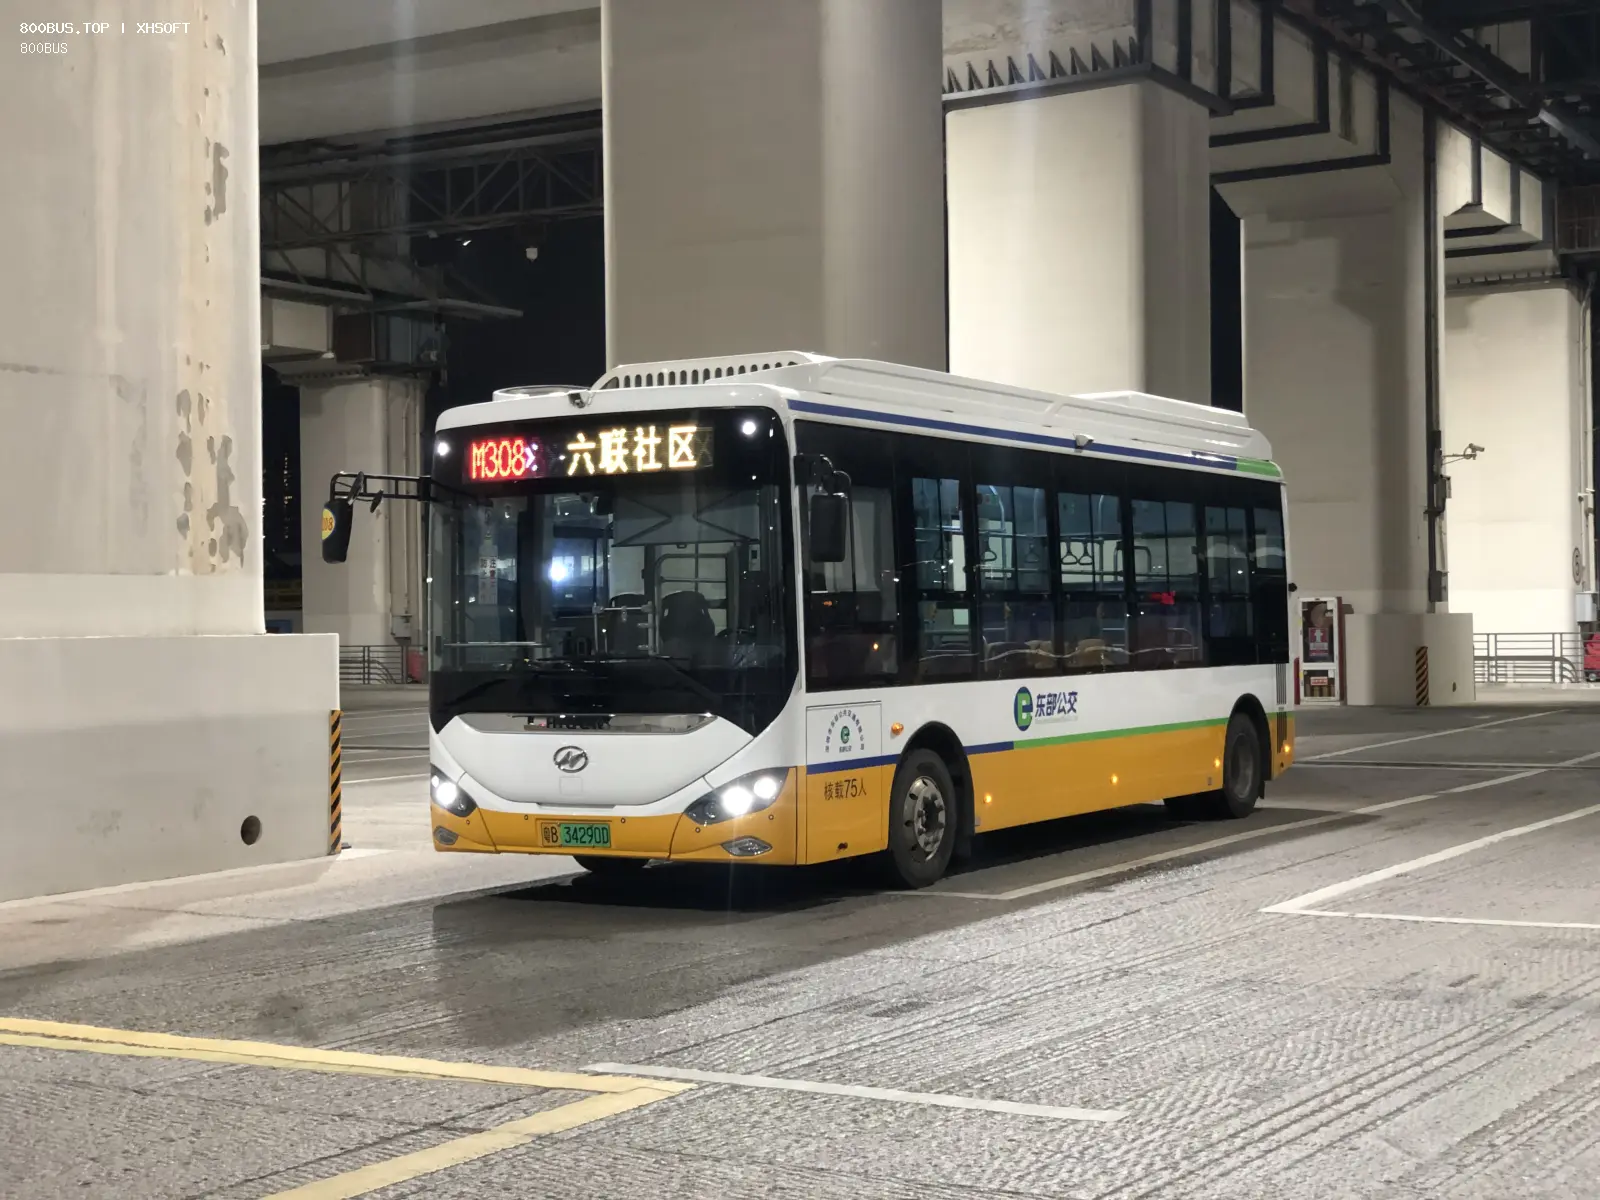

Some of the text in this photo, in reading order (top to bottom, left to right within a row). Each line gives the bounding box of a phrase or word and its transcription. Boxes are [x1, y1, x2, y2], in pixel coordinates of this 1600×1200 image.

[471, 439, 526, 479] M308
[566, 425, 698, 475] 六联社区
[1035, 691, 1079, 717] 东部公交
[824, 778, 867, 801] 核载75人
[564, 826, 609, 844] 34290D
